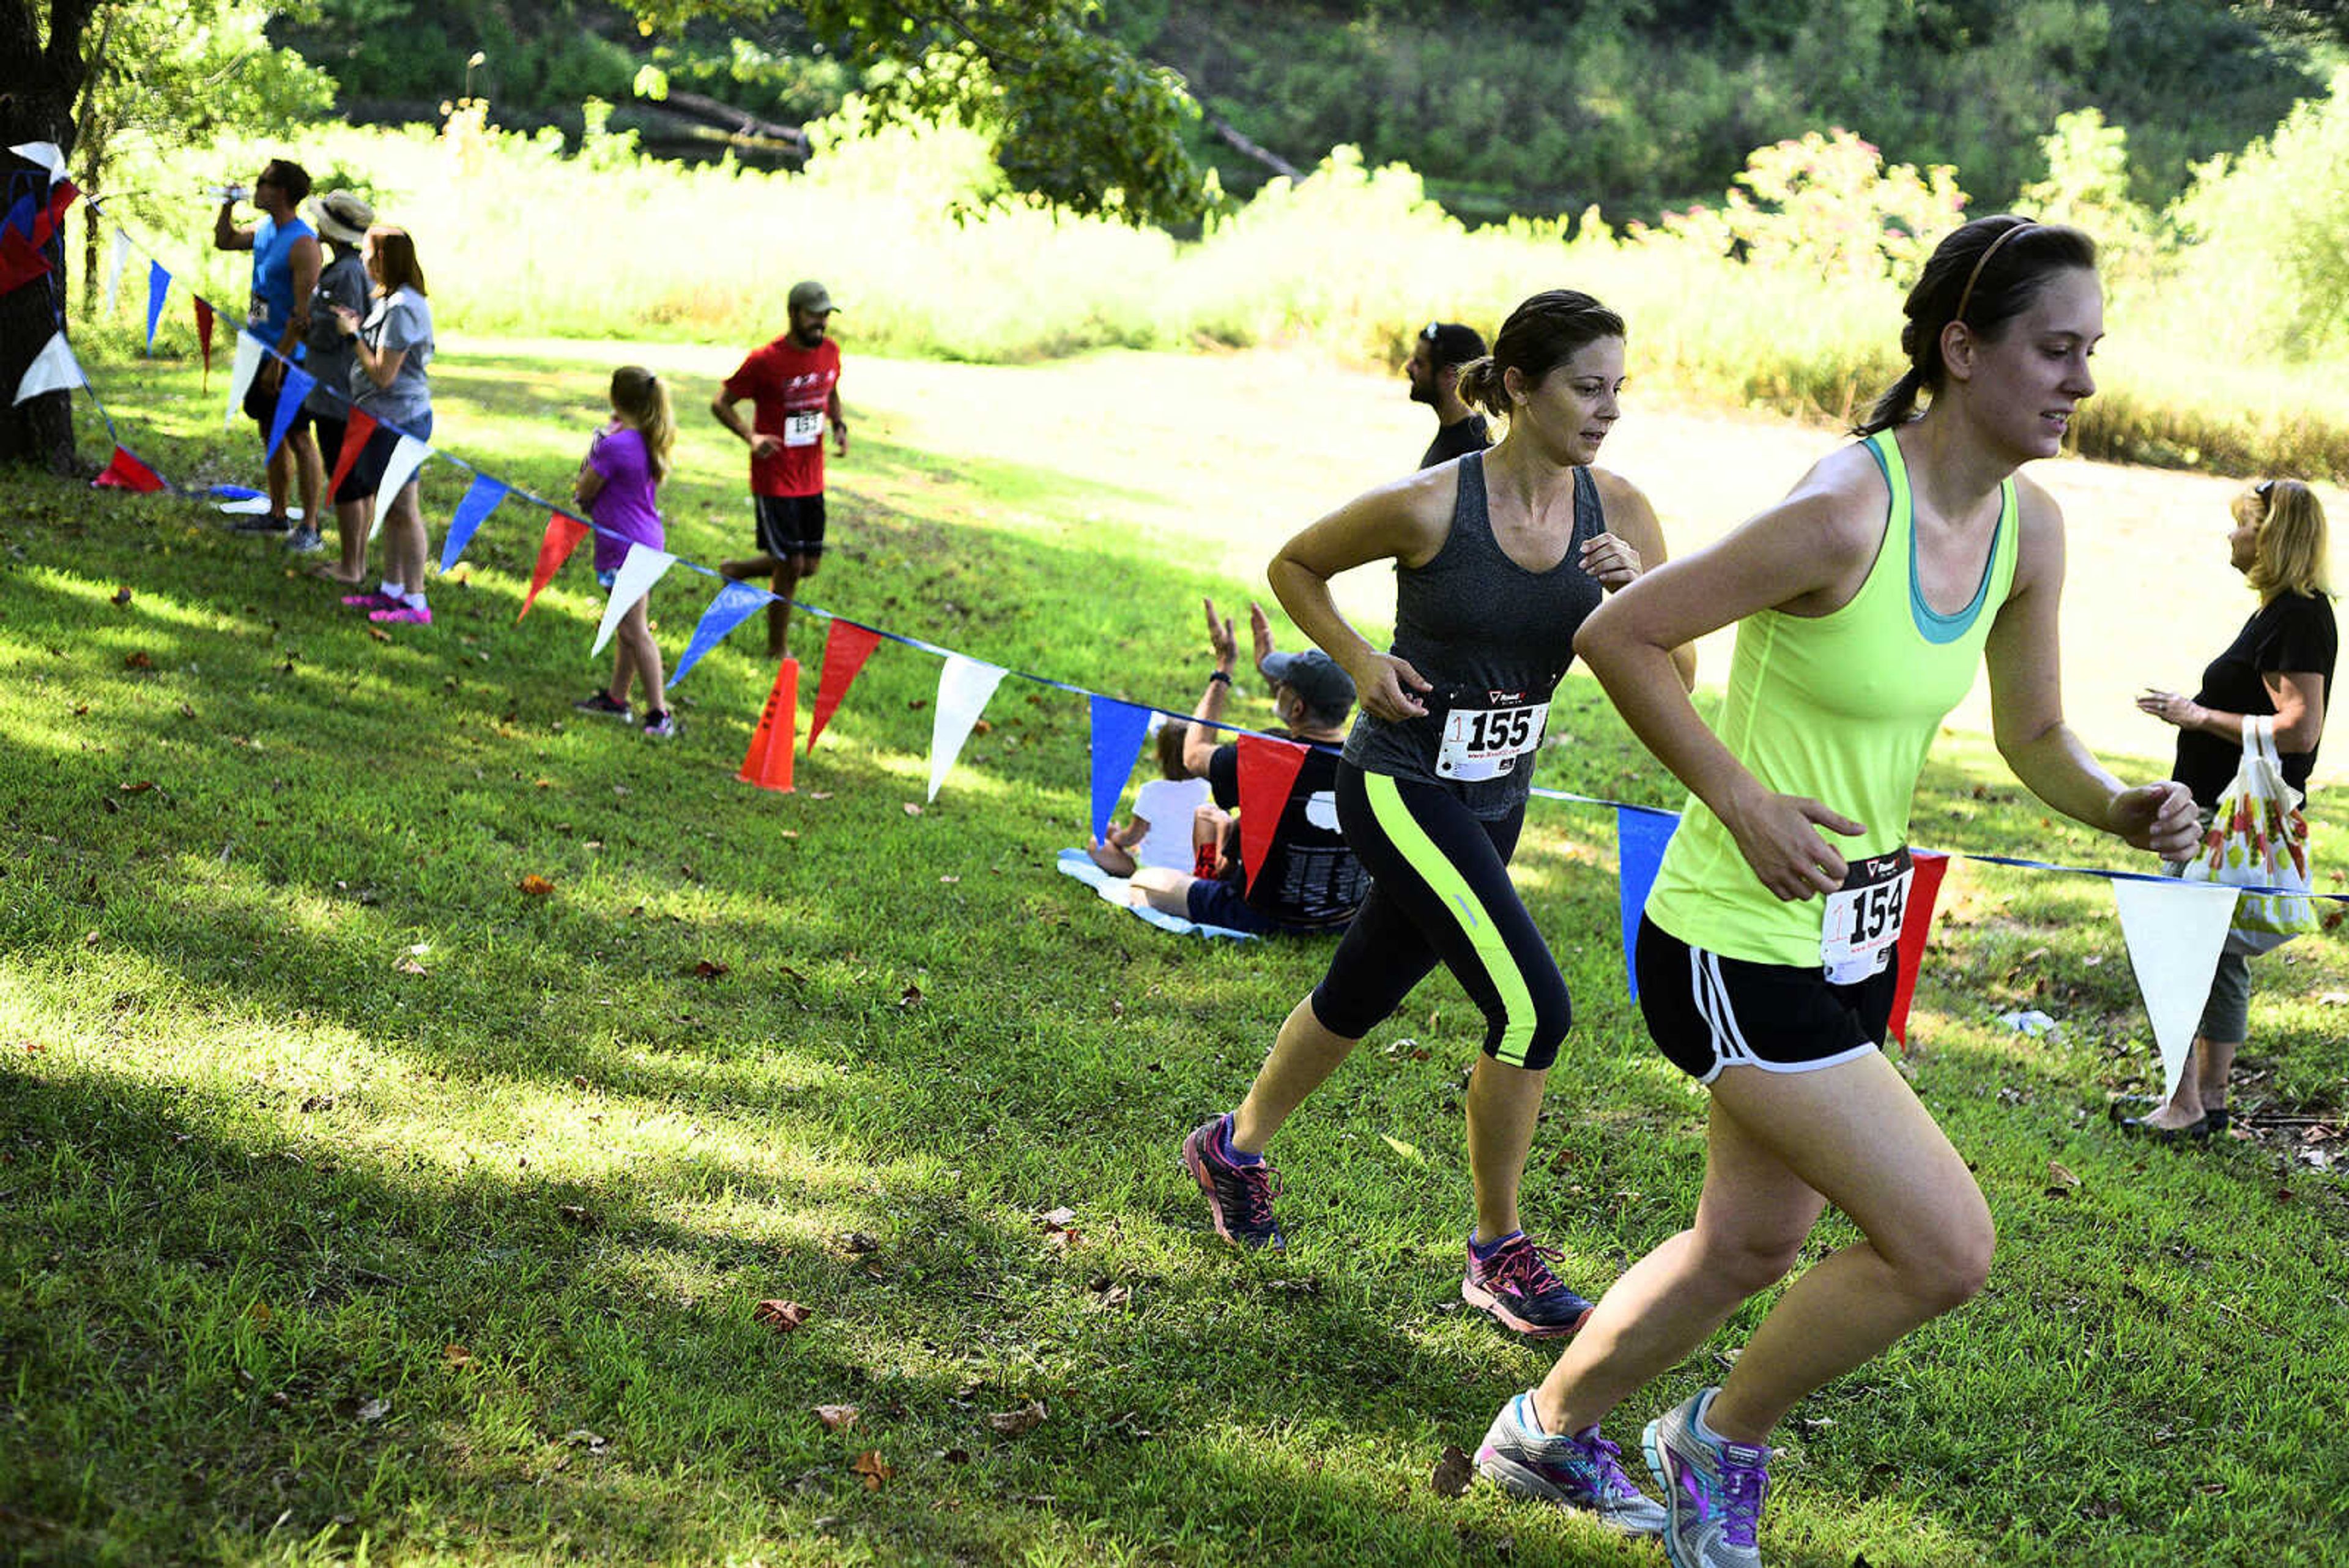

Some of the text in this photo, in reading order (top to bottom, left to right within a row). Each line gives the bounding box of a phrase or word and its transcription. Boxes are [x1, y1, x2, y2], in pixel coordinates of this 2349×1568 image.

[1467, 708, 1533, 751] 155
[1850, 877, 1902, 945] 154
[2243, 899, 2309, 923] ALDI
